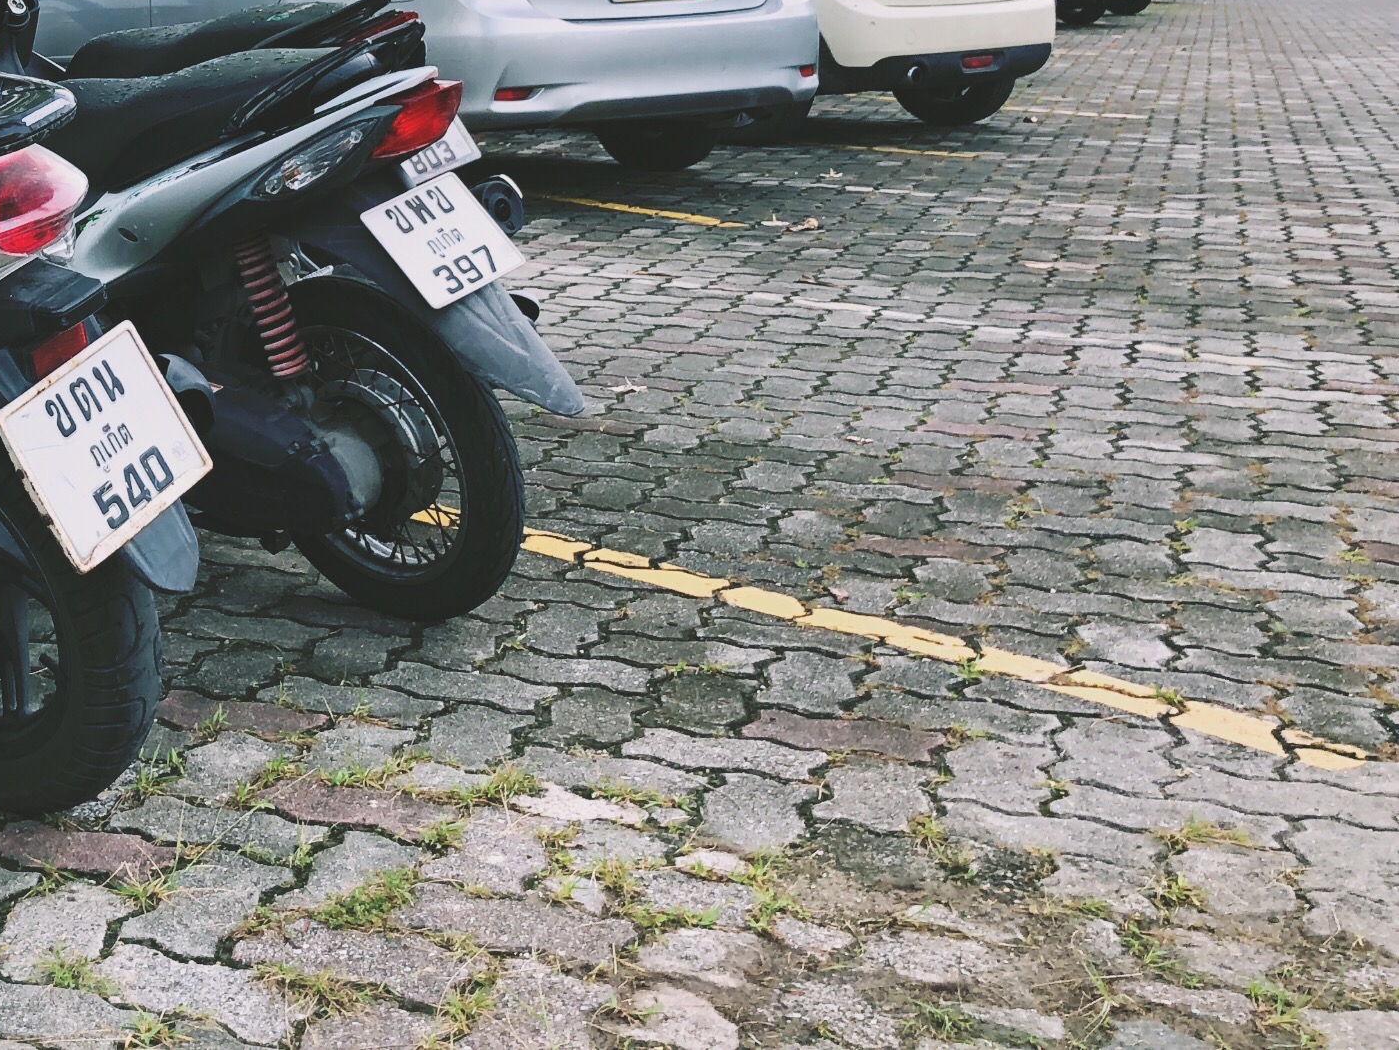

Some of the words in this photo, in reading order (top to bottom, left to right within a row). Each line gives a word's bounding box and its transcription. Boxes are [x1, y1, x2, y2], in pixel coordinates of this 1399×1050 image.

[410, 140, 457, 175] 803
[426, 227, 465, 258] ภูเก็ต
[432, 244, 497, 295] 397
[89, 422, 134, 473] ภูเก็ต
[93, 445, 175, 530] 540
